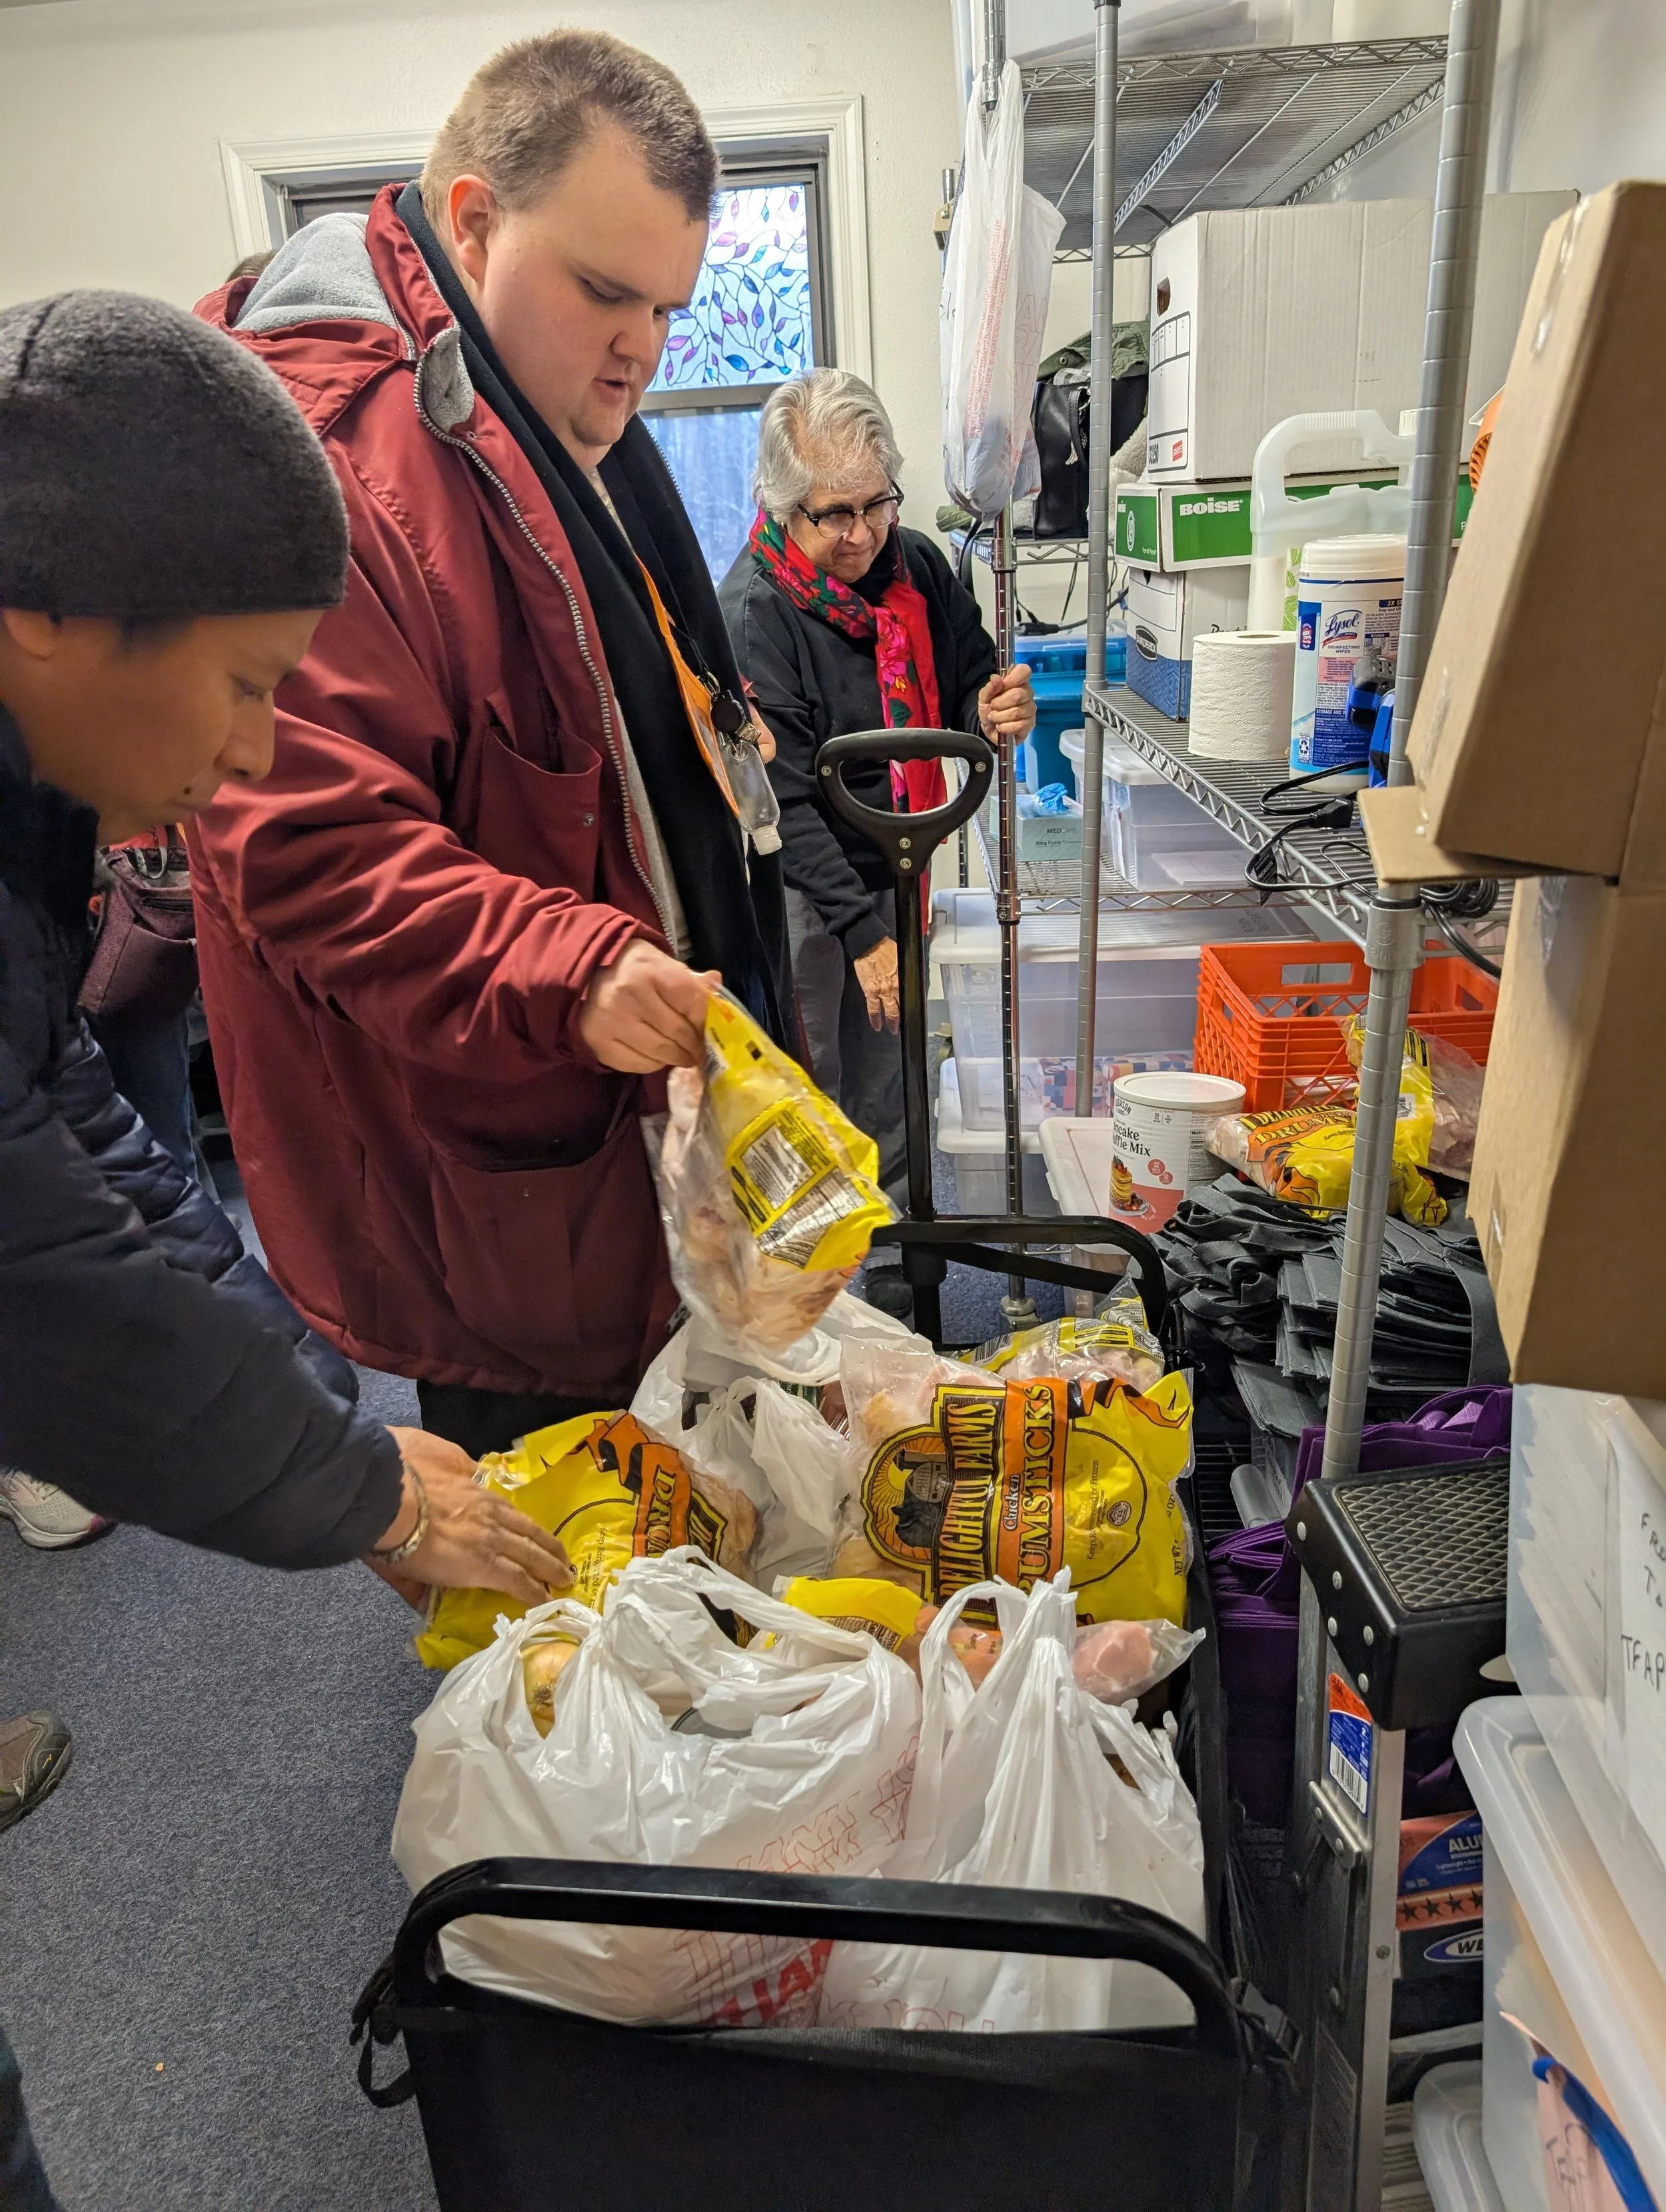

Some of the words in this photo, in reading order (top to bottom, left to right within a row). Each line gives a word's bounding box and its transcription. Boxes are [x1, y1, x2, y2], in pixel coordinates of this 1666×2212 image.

[1325, 613, 1359, 637] Lysol
[1130, 1141, 1151, 1157] Mix
[946, 1401, 998, 1467] FARMS
[1088, 1460, 1099, 1486] Frozen
[1002, 1473, 1020, 1532] Chicken
[1086, 1539, 1096, 1560] Keep
[1172, 1544, 1181, 1558] WT
[1174, 1560, 1182, 1576] NET
